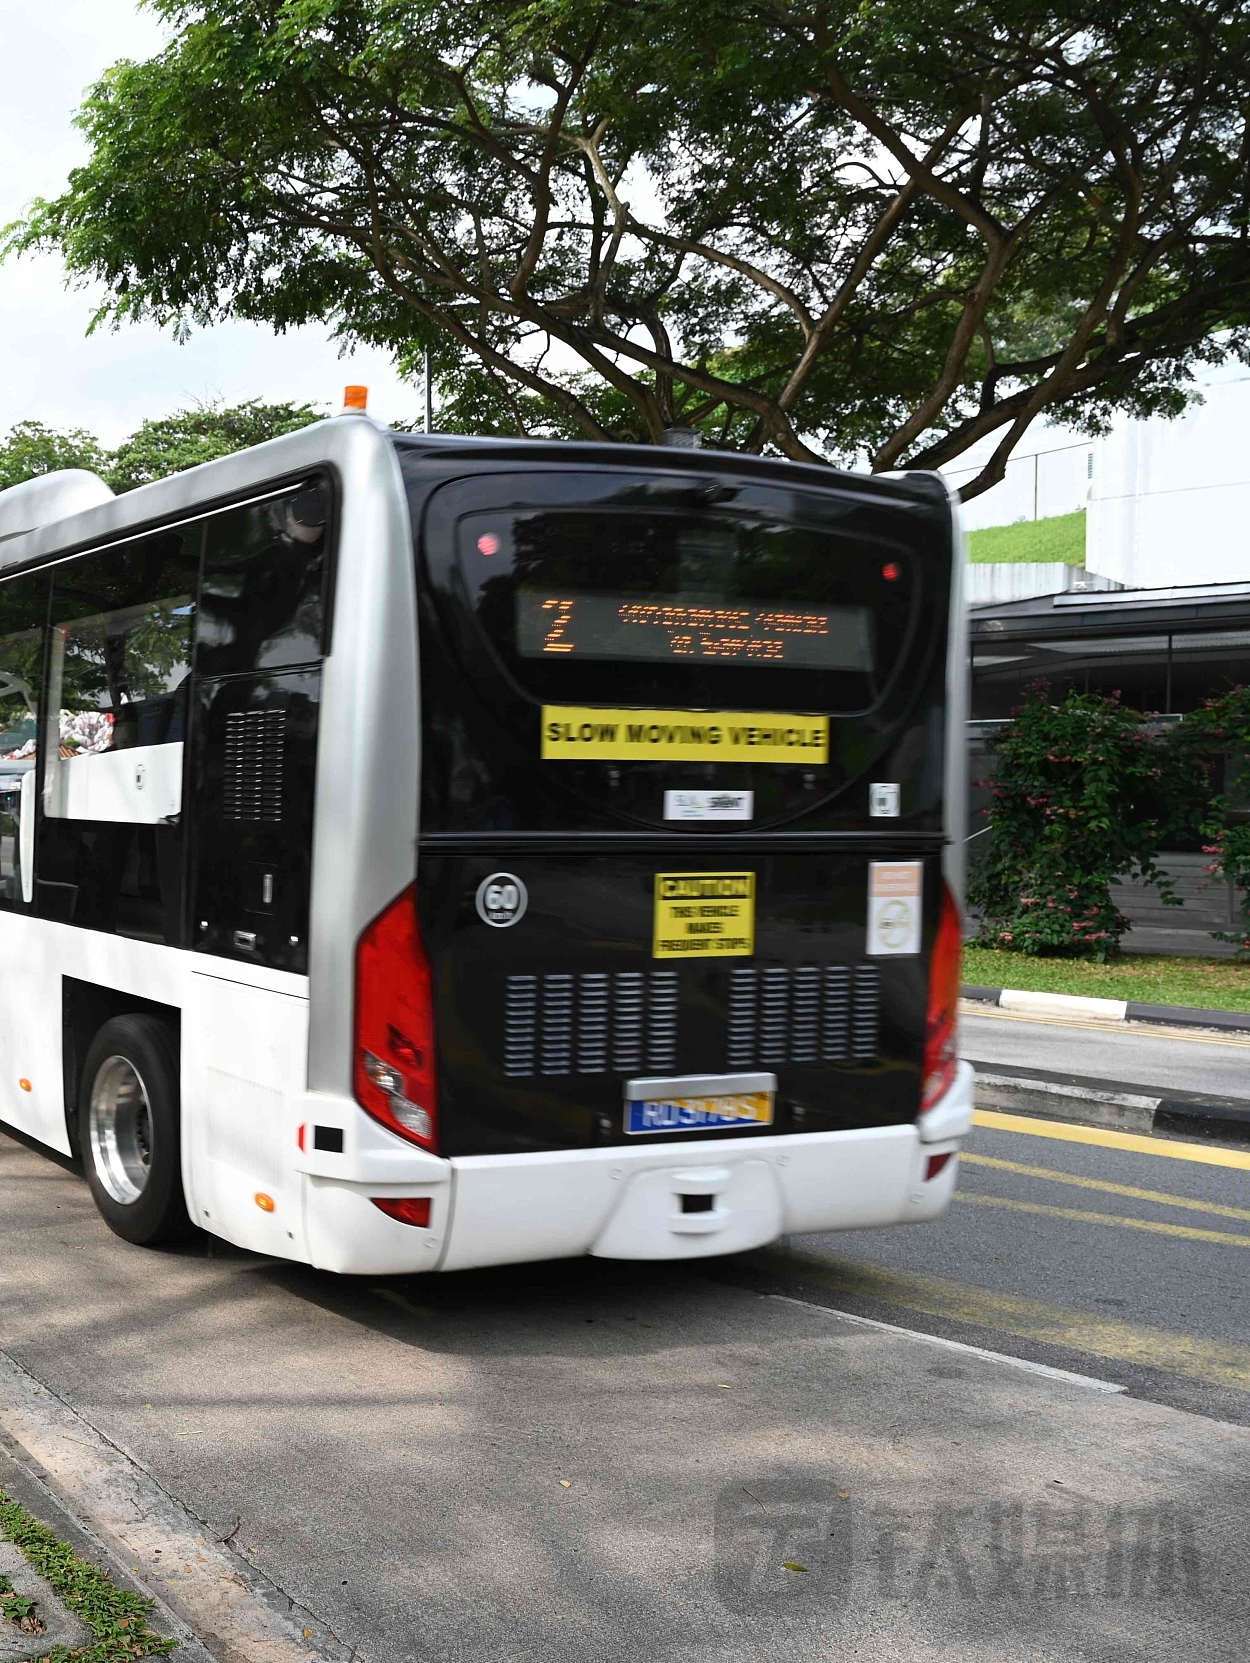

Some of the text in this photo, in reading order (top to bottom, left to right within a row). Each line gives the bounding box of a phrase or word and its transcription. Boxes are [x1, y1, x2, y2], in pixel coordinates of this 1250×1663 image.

[548, 722, 827, 748] SLOW MOVING VEHICLE
[485, 884, 519, 910] 60
[660, 879, 750, 897] CAUTION
